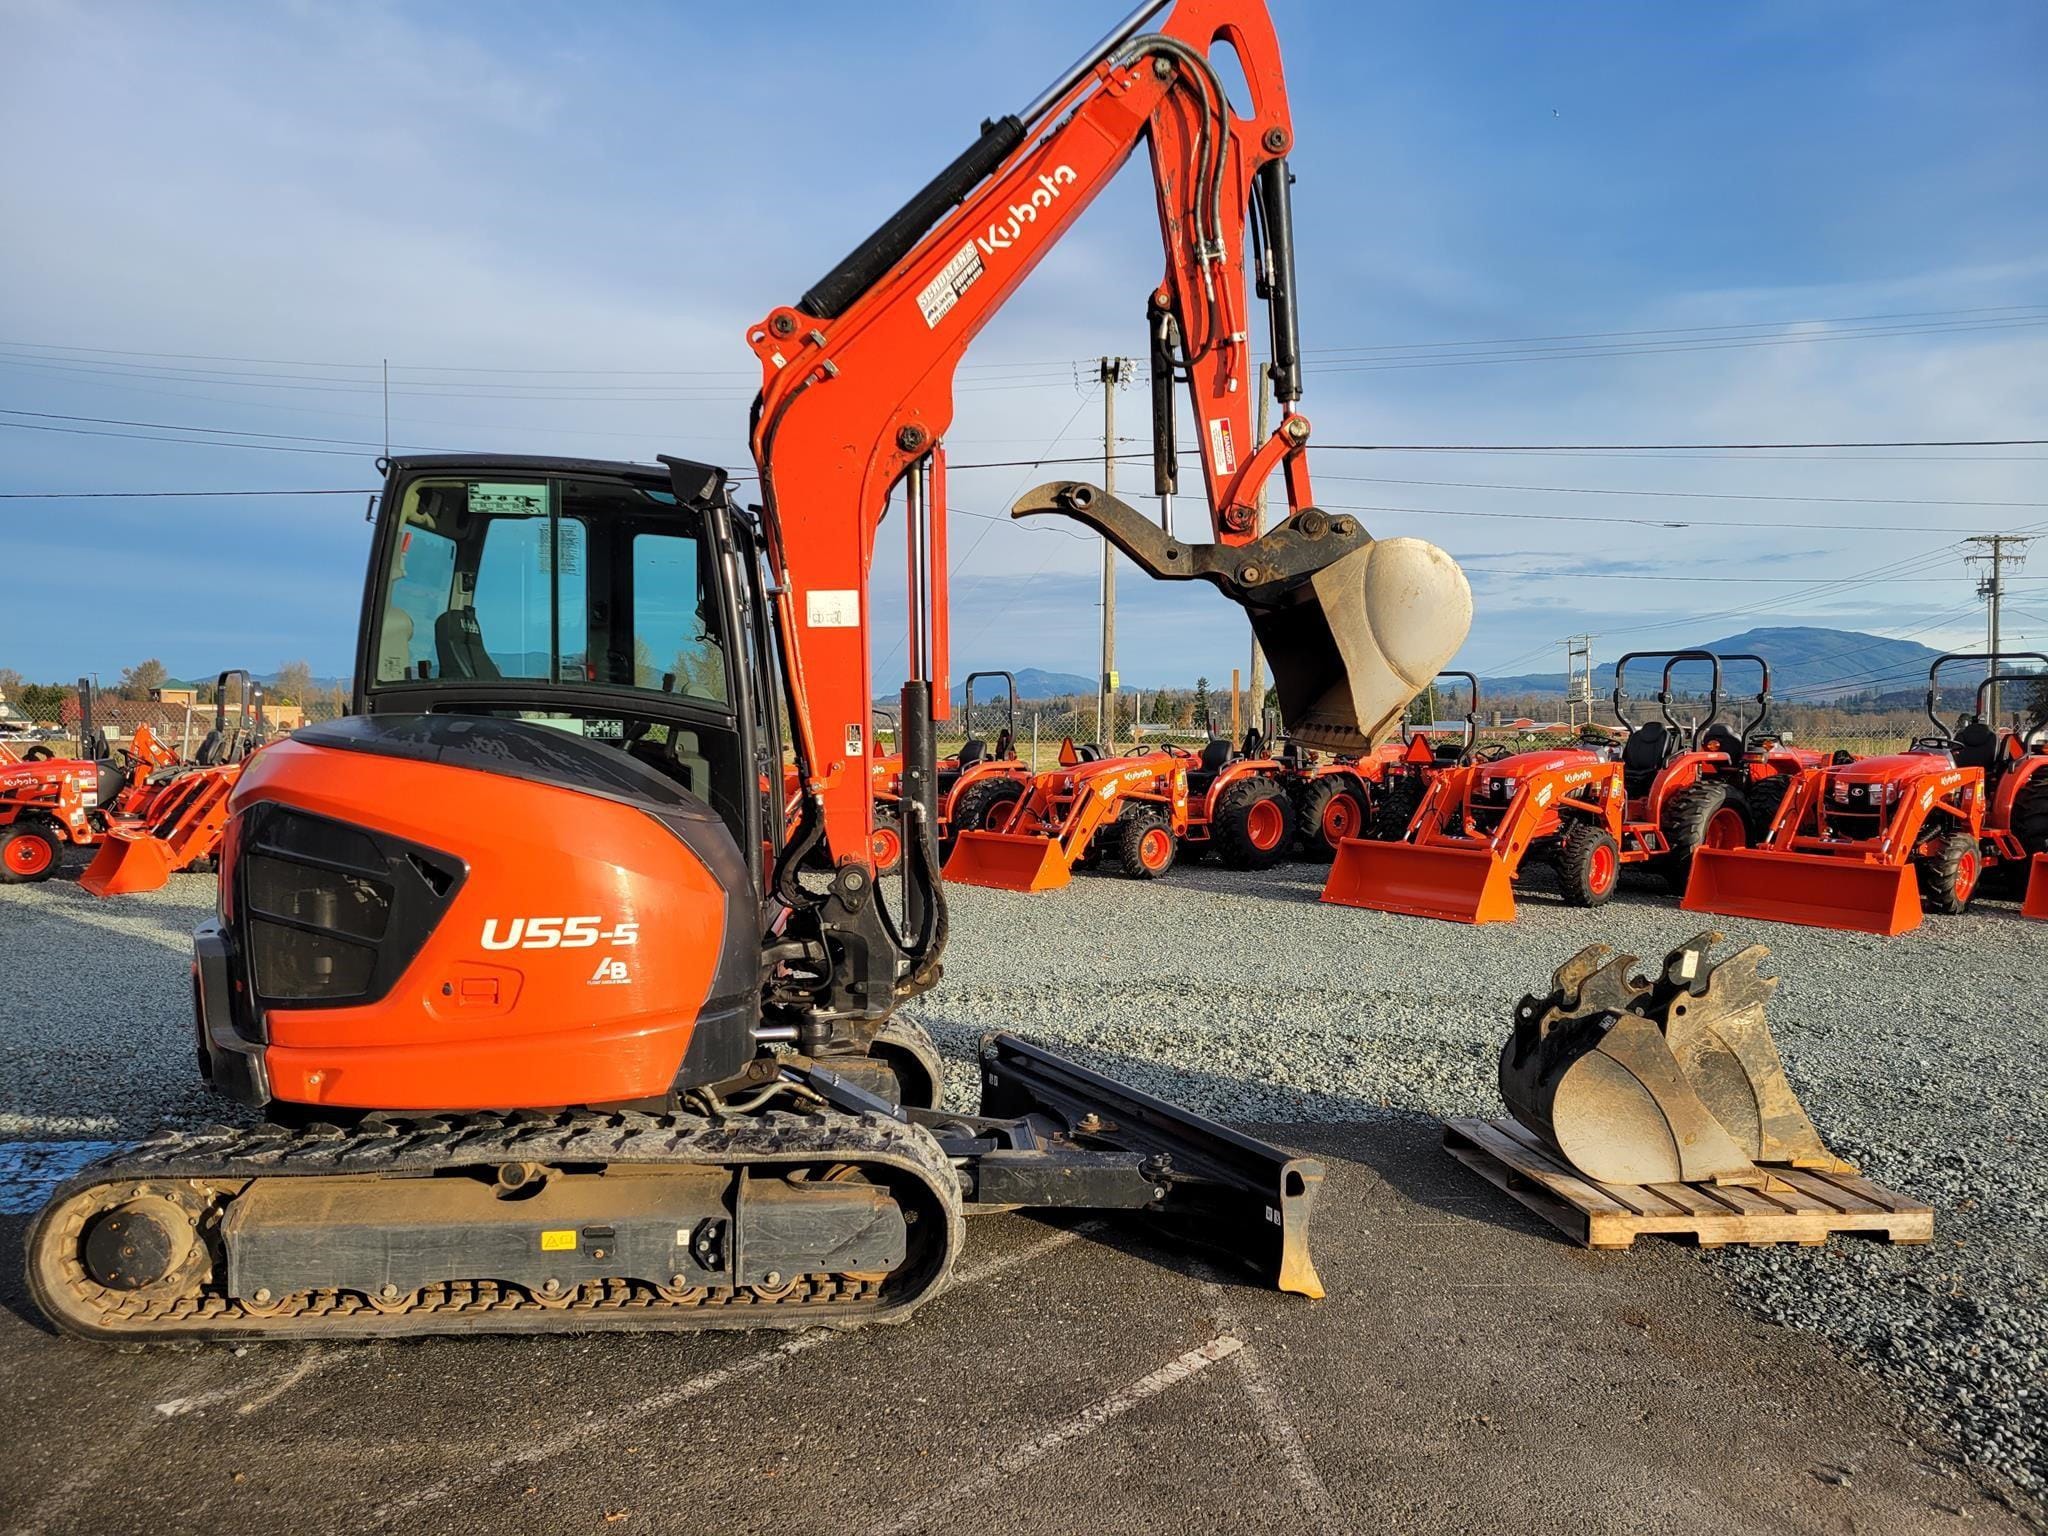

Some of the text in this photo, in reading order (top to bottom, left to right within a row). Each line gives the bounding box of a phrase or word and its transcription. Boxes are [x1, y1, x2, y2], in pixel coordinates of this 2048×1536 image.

[977, 164, 1078, 256] Kubota
[1223, 436, 1234, 465] DANGER
[3, 777, 39, 787] Kubota
[1123, 768, 1153, 781] Kubota
[1564, 769, 1592, 784] Kubota
[480, 915, 640, 951] U55-5
[591, 956, 628, 980] AB
